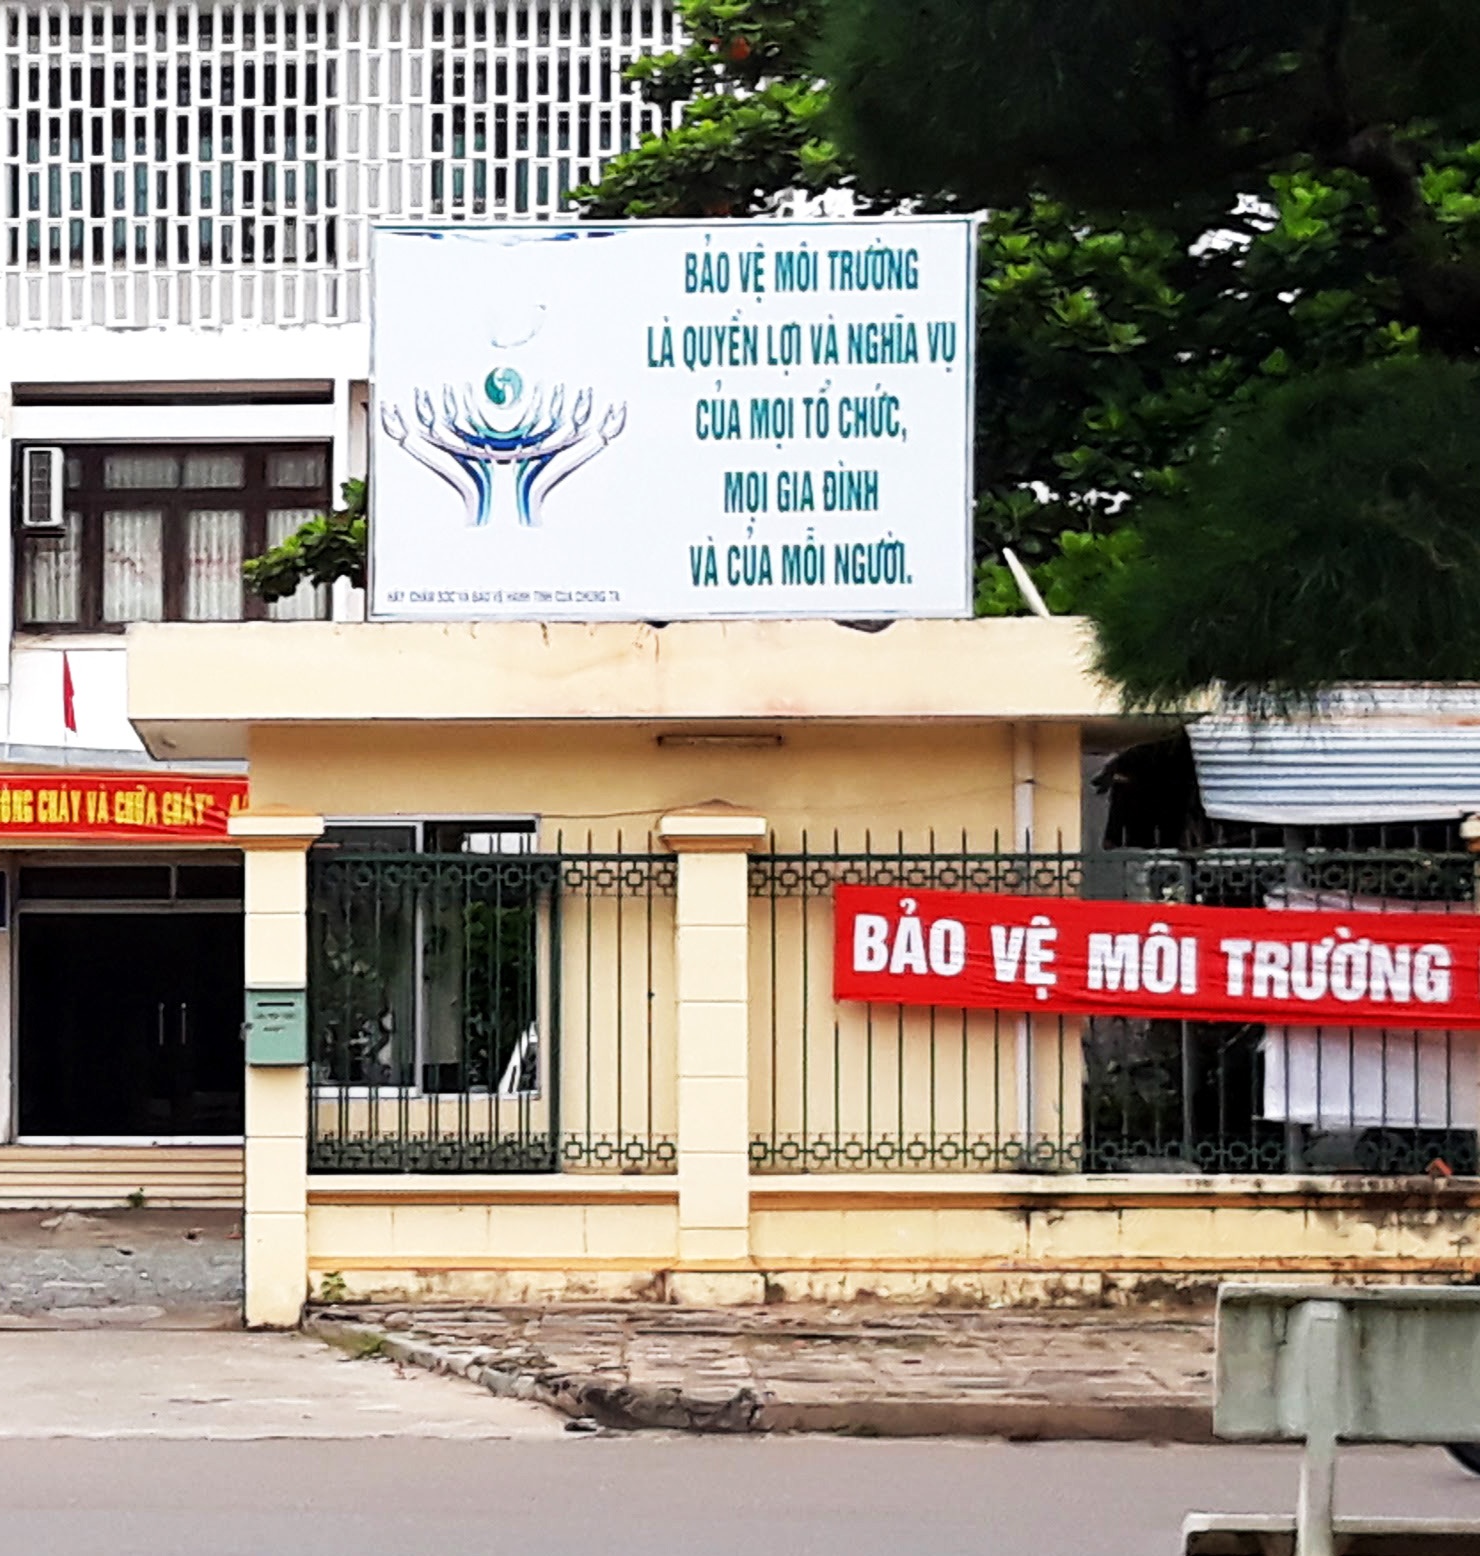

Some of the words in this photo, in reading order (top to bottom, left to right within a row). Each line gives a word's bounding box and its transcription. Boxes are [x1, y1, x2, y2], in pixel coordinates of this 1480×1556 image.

[685, 234, 730, 294] BẢO
[740, 243, 766, 304] VỆ
[774, 243, 819, 292] MÔI
[826, 237, 918, 292] TRƯỜNG
[647, 317, 674, 368] LÀ
[682, 311, 758, 370] QUYỀN
[766, 323, 802, 375] LỢI
[810, 314, 839, 365] VÀ
[847, 314, 918, 364] NGHĨA
[926, 322, 956, 373] VỤ
[696, 380, 741, 440] CỦA
[750, 398, 794, 449] MỌI
[802, 380, 830, 438] TỔ
[838, 382, 908, 444] CHỨC,
[724, 470, 768, 522] MỌI
[776, 470, 815, 512] GIA
[822, 460, 878, 512] ĐÌNH
[690, 536, 720, 586] VÀ
[728, 524, 774, 585] CỦA
[782, 528, 825, 584] MỖI
[834, 530, 912, 584] NGƯỜI.
[37, 784, 81, 823] CHÁY
[87, 783, 109, 823] VÀ
[115, 784, 157, 825] CHỮA
[853, 898, 967, 976] BẢO
[991, 916, 1057, 1000] VỆ
[1087, 923, 1197, 994] MÔI
[1220, 926, 1452, 1003] TRƯỜNG
